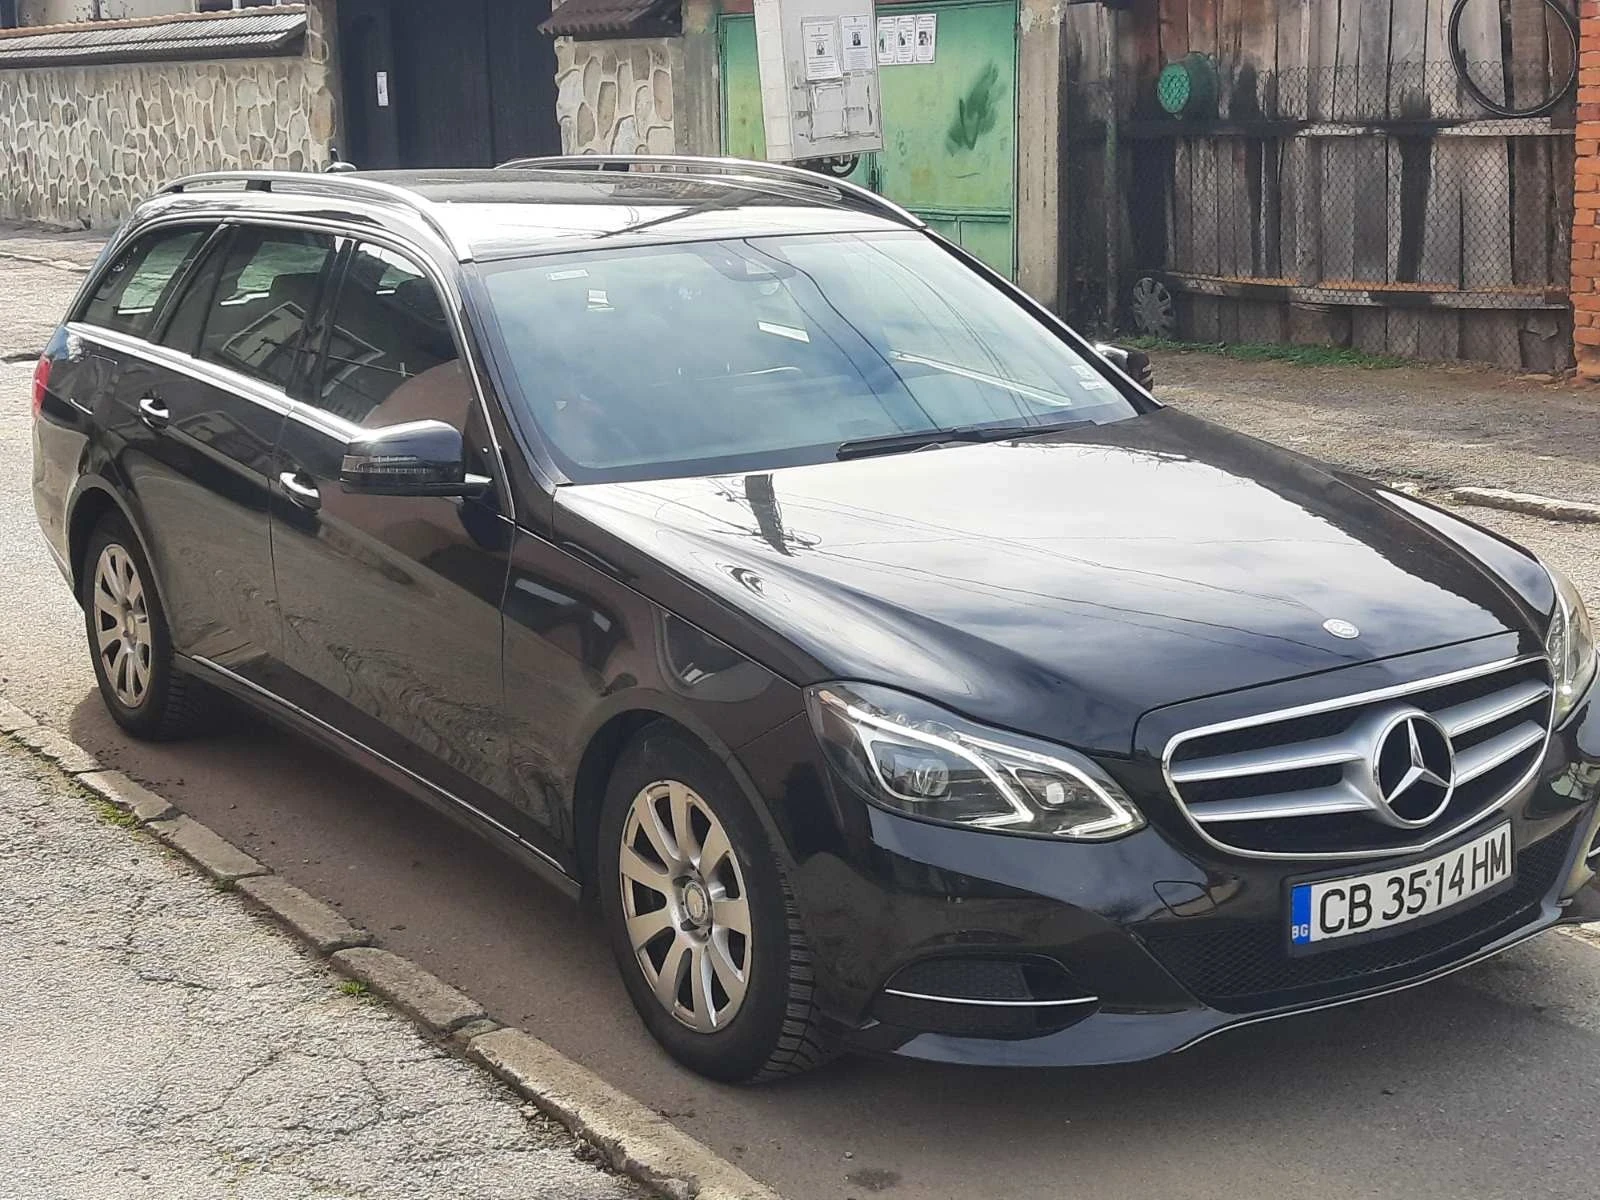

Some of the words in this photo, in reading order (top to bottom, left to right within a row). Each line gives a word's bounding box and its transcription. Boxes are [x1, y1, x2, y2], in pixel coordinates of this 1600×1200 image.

[1319, 883, 1372, 934] CB
[1382, 853, 1465, 921] 3514
[1471, 831, 1507, 890] HM
[1292, 924, 1309, 940] BG
